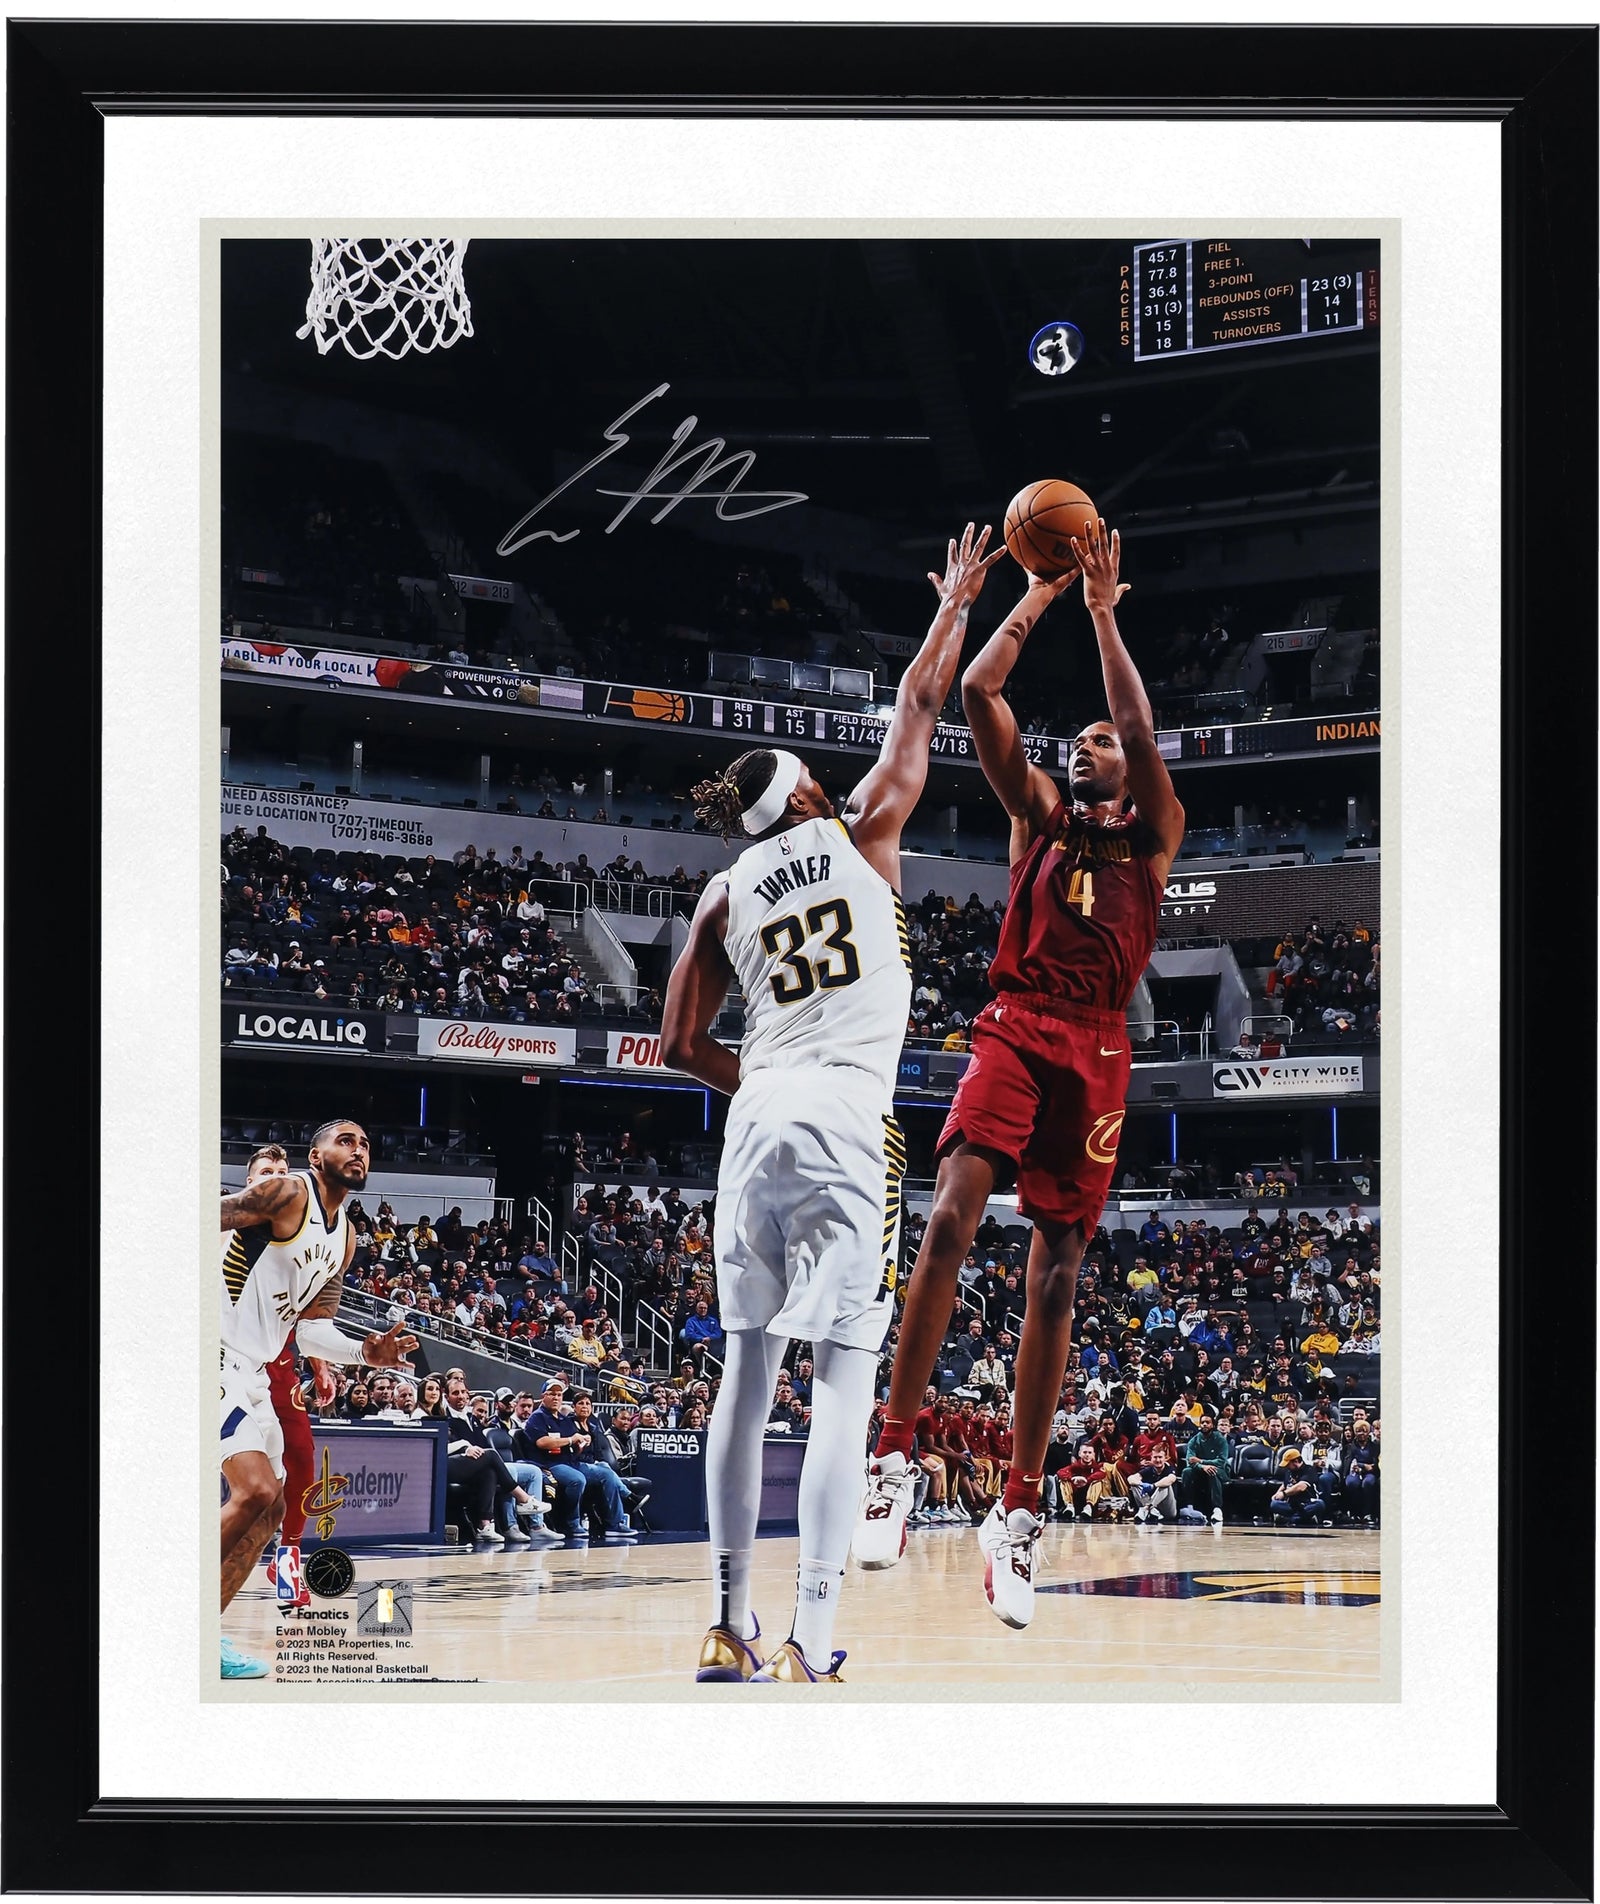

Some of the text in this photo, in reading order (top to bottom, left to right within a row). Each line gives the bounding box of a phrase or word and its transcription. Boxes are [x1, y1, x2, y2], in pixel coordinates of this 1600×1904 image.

[1148, 249, 1177, 263] 45.7
[1204, 259, 1232, 272] FREE
[1148, 267, 1177, 281] 77.8
[1312, 274, 1351, 292] 23 (3)
[1148, 284, 1177, 299] 36.4
[1199, 284, 1294, 308] REBOUNDS (OFF)
[1120, 265, 1130, 346] PACERS
[1144, 300, 1183, 317] 31 (3)
[1325, 295, 1340, 308] 14
[1222, 306, 1270, 322] ASSISTS
[1325, 312, 1339, 326] 11
[1156, 320, 1171, 332] 15
[1213, 322, 1281, 340] TURNOVERS
[1156, 337, 1172, 350] 18
[492, 586, 509, 599] 213
[1267, 638, 1284, 650] 215
[269, 655, 283, 665] AT
[288, 656, 321, 670] YOUR
[325, 660, 362, 675] LOCAL
[444, 669, 532, 686] @POWERUPSNACKS
[734, 701, 753, 712] REB
[786, 708, 804, 718] AST
[733, 712, 752, 729] 31
[786, 718, 805, 735] 15
[833, 714, 858, 725] FIELD
[837, 725, 885, 745] 21/46
[1194, 730, 1211, 739] FLS
[1036, 738, 1048, 748] FG
[1200, 740, 1206, 755] 1
[222, 787, 349, 810] NEED ASSISTANCE?
[244, 803, 254, 816] &
[256, 805, 318, 824] LOCATION
[319, 812, 335, 824] TO
[338, 813, 425, 834] 707-TIMEOUT.
[332, 826, 433, 846] (707) 846-3688
[562, 829, 567, 841] 7
[622, 834, 628, 847] 8
[753, 854, 831, 905] TURNER
[1067, 869, 1095, 917] 4
[1160, 905, 1210, 916] LOFT
[760, 898, 862, 1006] 33
[438, 1022, 556, 1057] Bally SPORTS
[616, 1036, 663, 1067] POI
[901, 1064, 921, 1075] HQ
[1273, 1066, 1359, 1078] CITY WIDE
[488, 1178, 493, 1194] 7
[575, 1183, 580, 1198] 8
[293, 1244, 336, 1274] INDIAN
[272, 1292, 297, 1323] PAC
[641, 1433, 698, 1443] INDIANA
[654, 1443, 700, 1455] BOLD
